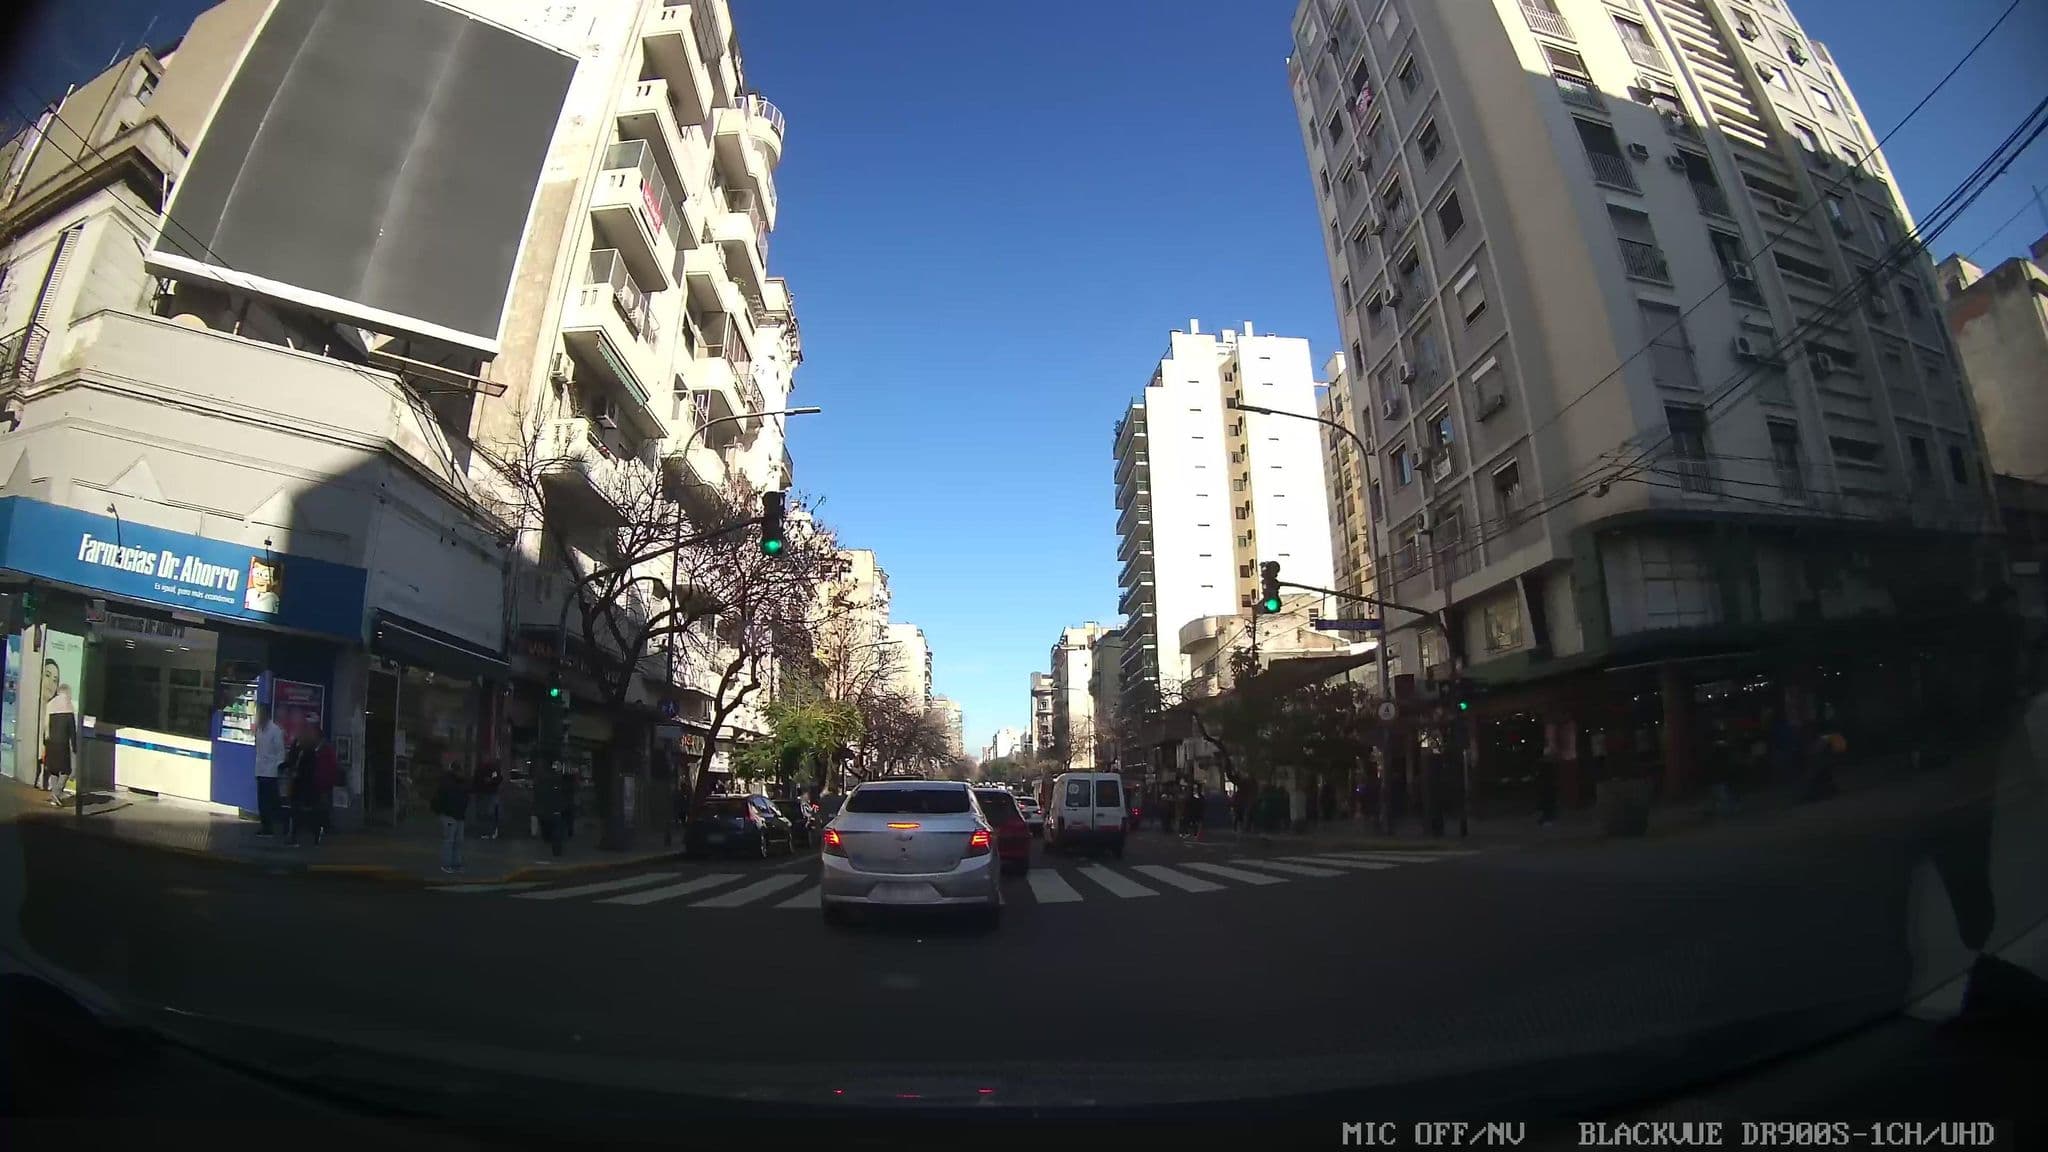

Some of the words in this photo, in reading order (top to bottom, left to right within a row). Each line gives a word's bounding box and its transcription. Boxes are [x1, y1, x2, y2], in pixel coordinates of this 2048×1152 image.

[78, 533, 156, 575] Farmacias
[157, 550, 180, 580] Dr.
[179, 555, 239, 591] Ahorro
